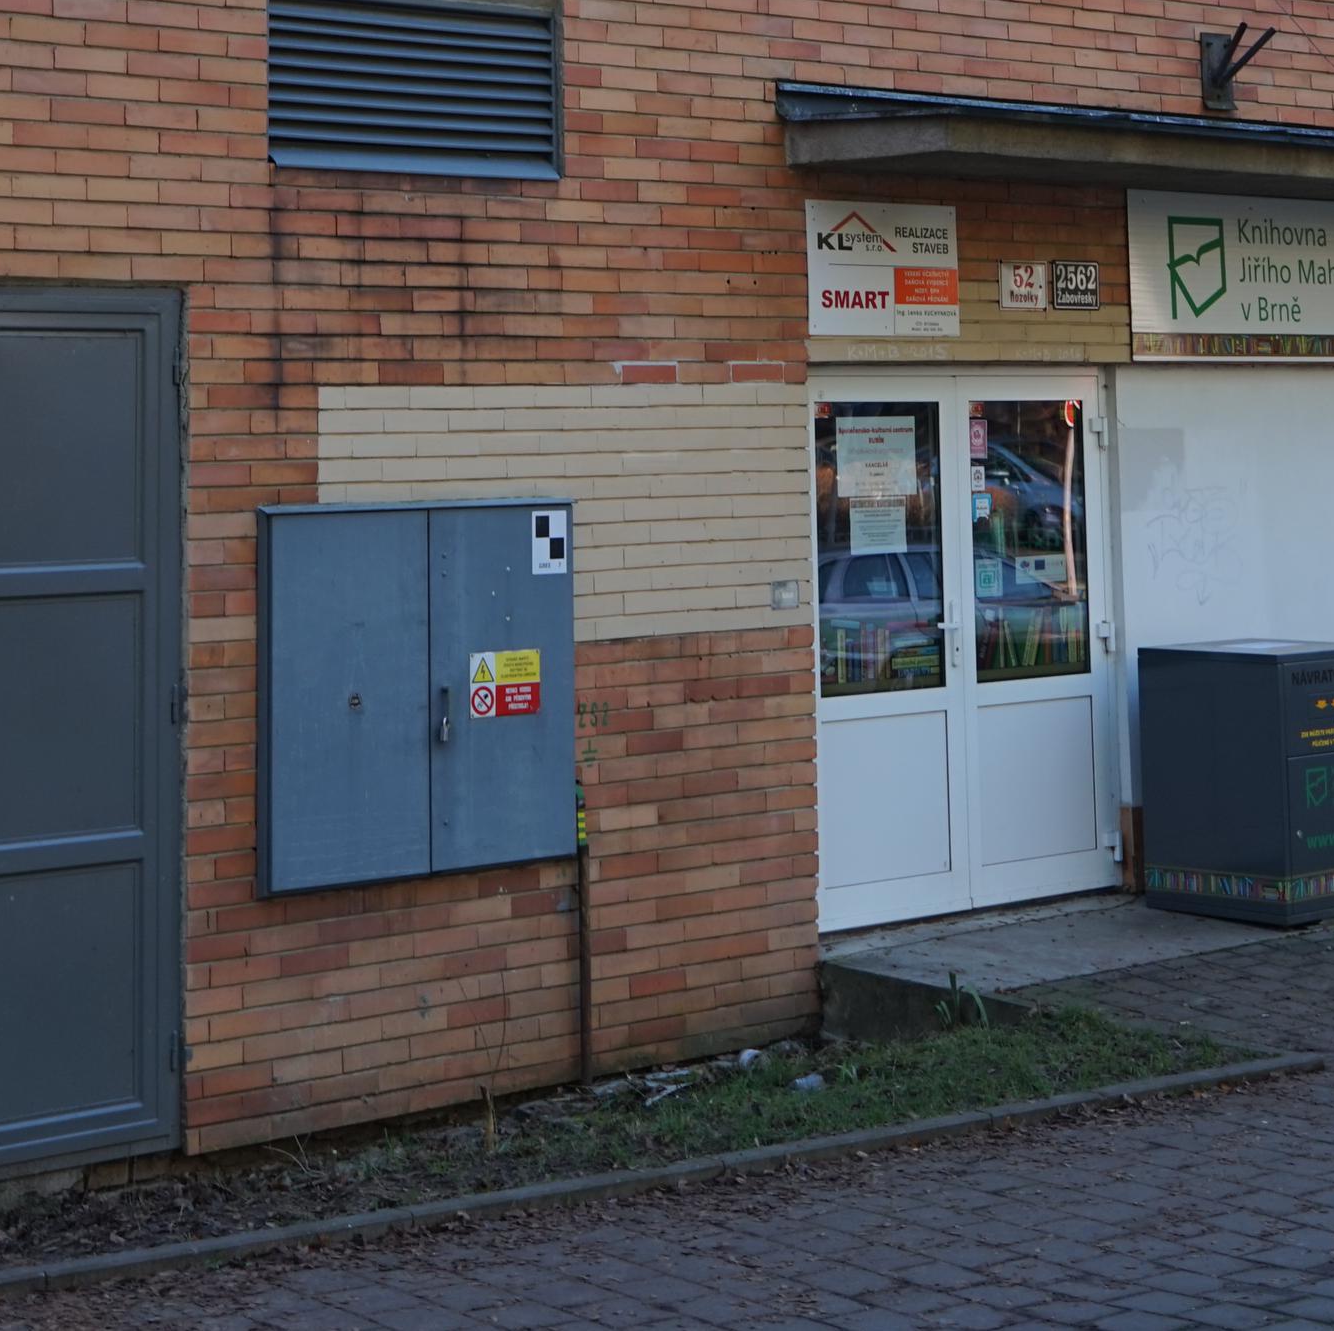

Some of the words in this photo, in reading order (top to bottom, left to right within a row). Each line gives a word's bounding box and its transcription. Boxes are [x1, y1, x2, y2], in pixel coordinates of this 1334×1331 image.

[817, 232, 853, 251] KL
[845, 231, 882, 245] system
[894, 226, 949, 240] REALIZACE
[1237, 218, 1327, 247] Knihovna
[865, 244, 884, 252] s.r.o.
[912, 243, 949, 254] STAVEB
[1013, 265, 1035, 288] 52
[1056, 265, 1097, 289] 2562
[1239, 256, 1292, 284] Jiřího
[821, 289, 890, 309] SMART
[1057, 288, 1097, 305] Žabovřesky
[1241, 302, 1251, 321] v
[1258, 296, 1301, 322] Brně
